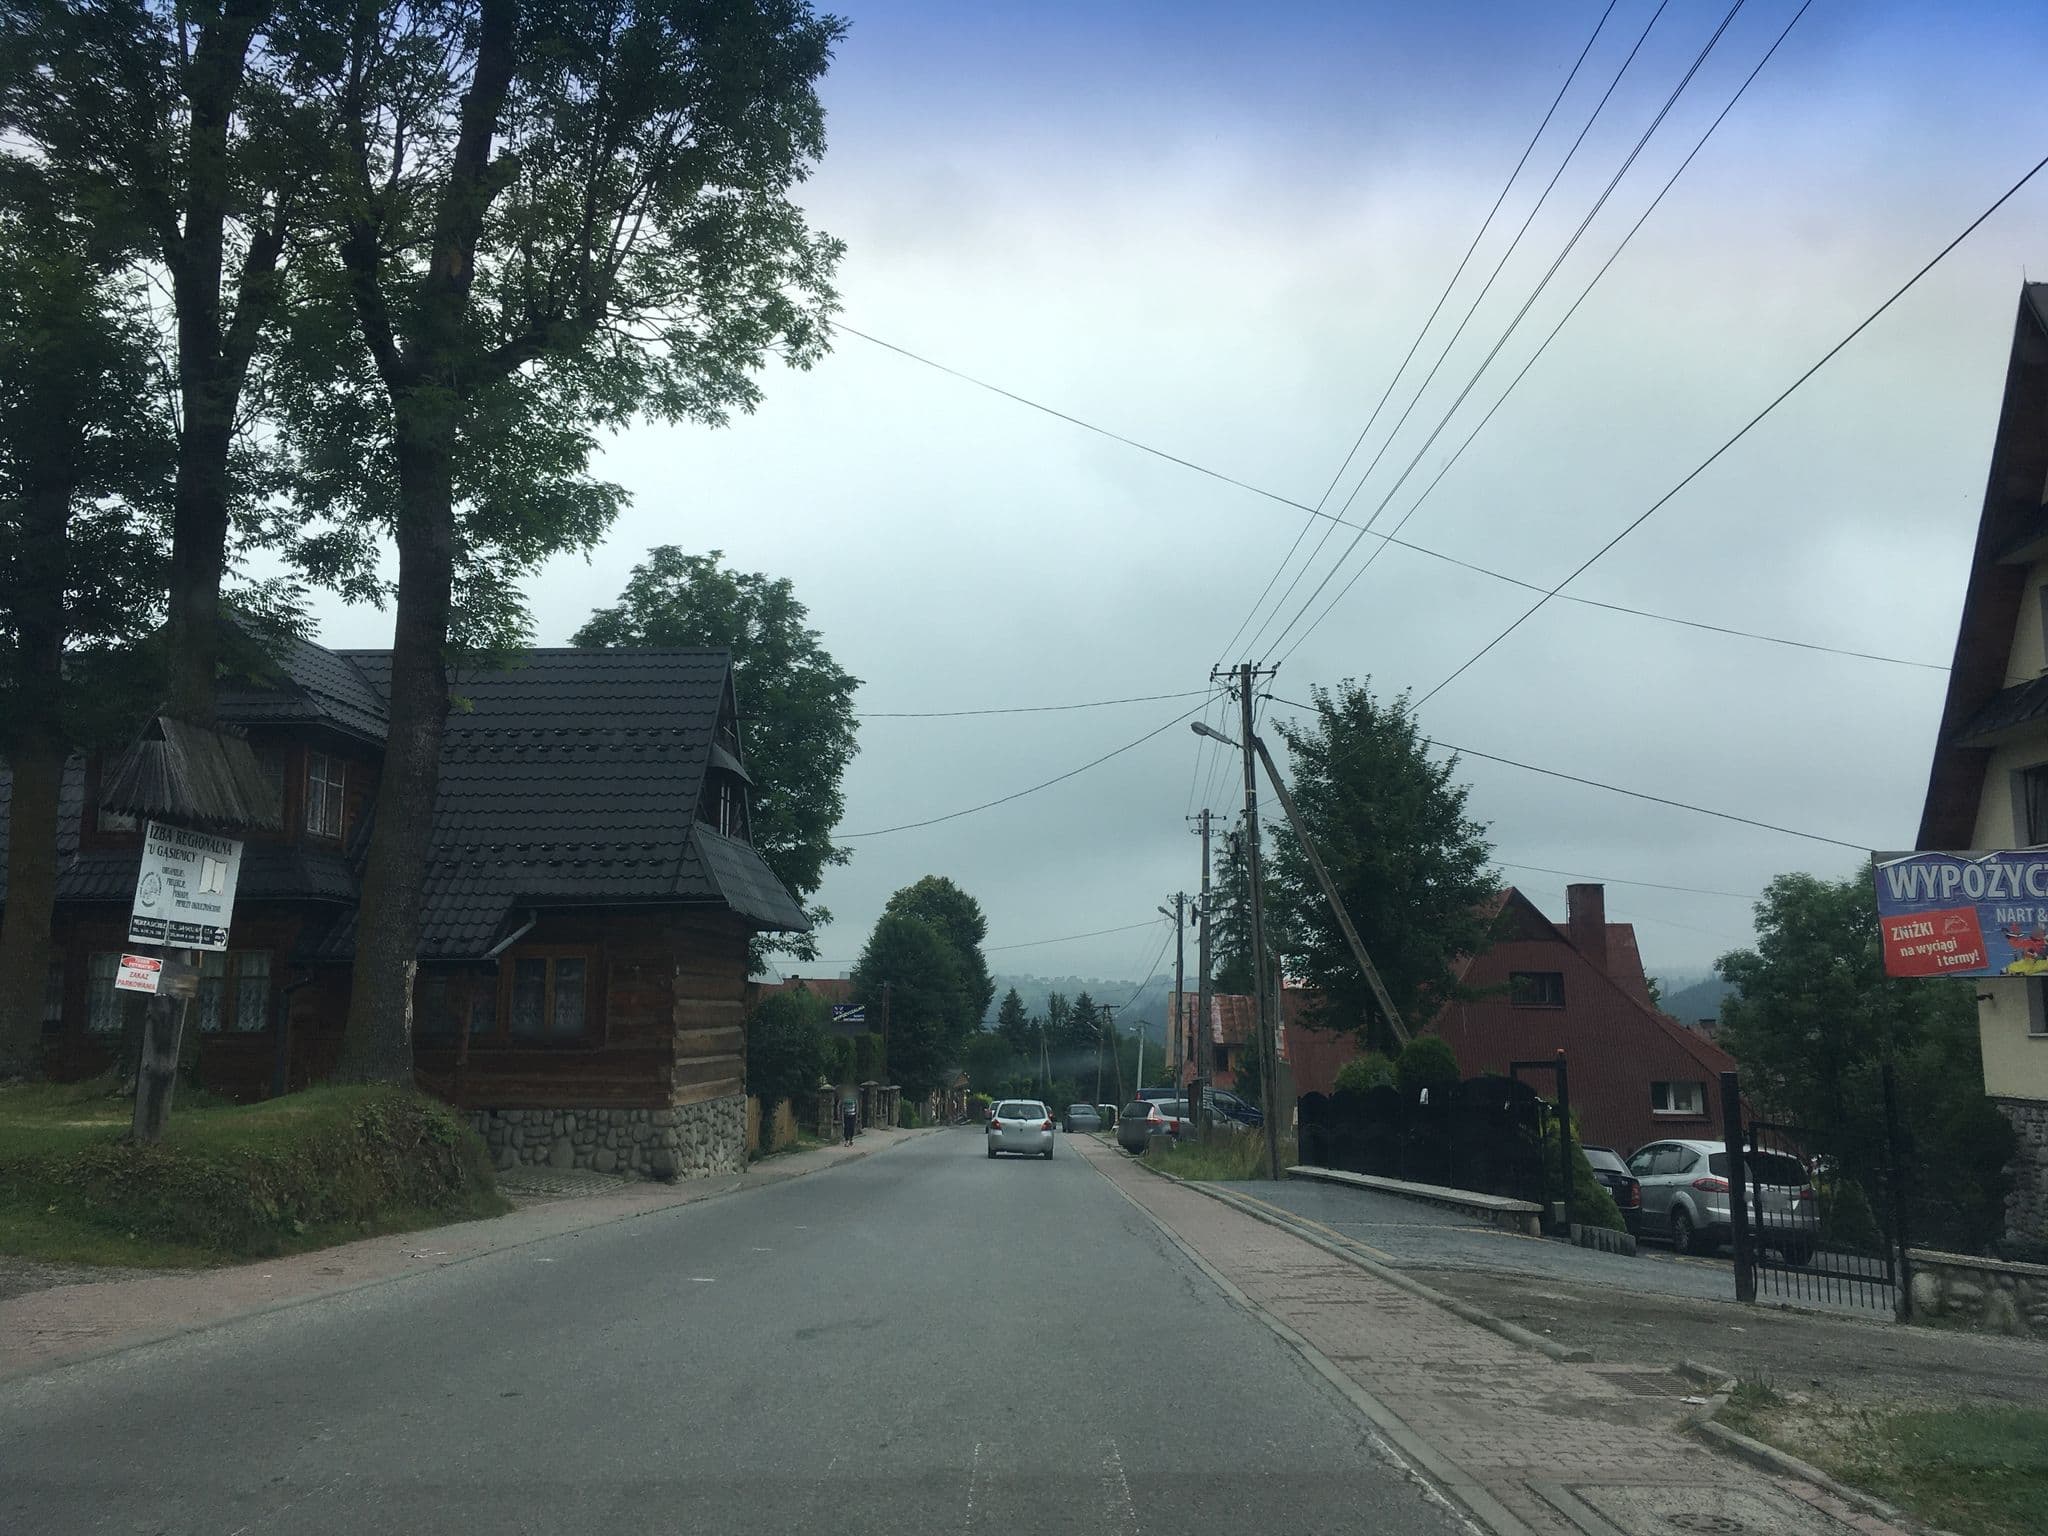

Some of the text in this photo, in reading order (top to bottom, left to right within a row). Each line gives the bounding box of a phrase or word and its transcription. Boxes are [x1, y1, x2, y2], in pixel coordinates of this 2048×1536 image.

[149, 824, 232, 856] IZBA REGIONALNA
[1996, 908, 2048, 923] NART &
[1900, 937, 1958, 957] na wyciągi
[1937, 949, 1980, 967] i termy!
[129, 971, 149, 980] ZAKAZ
